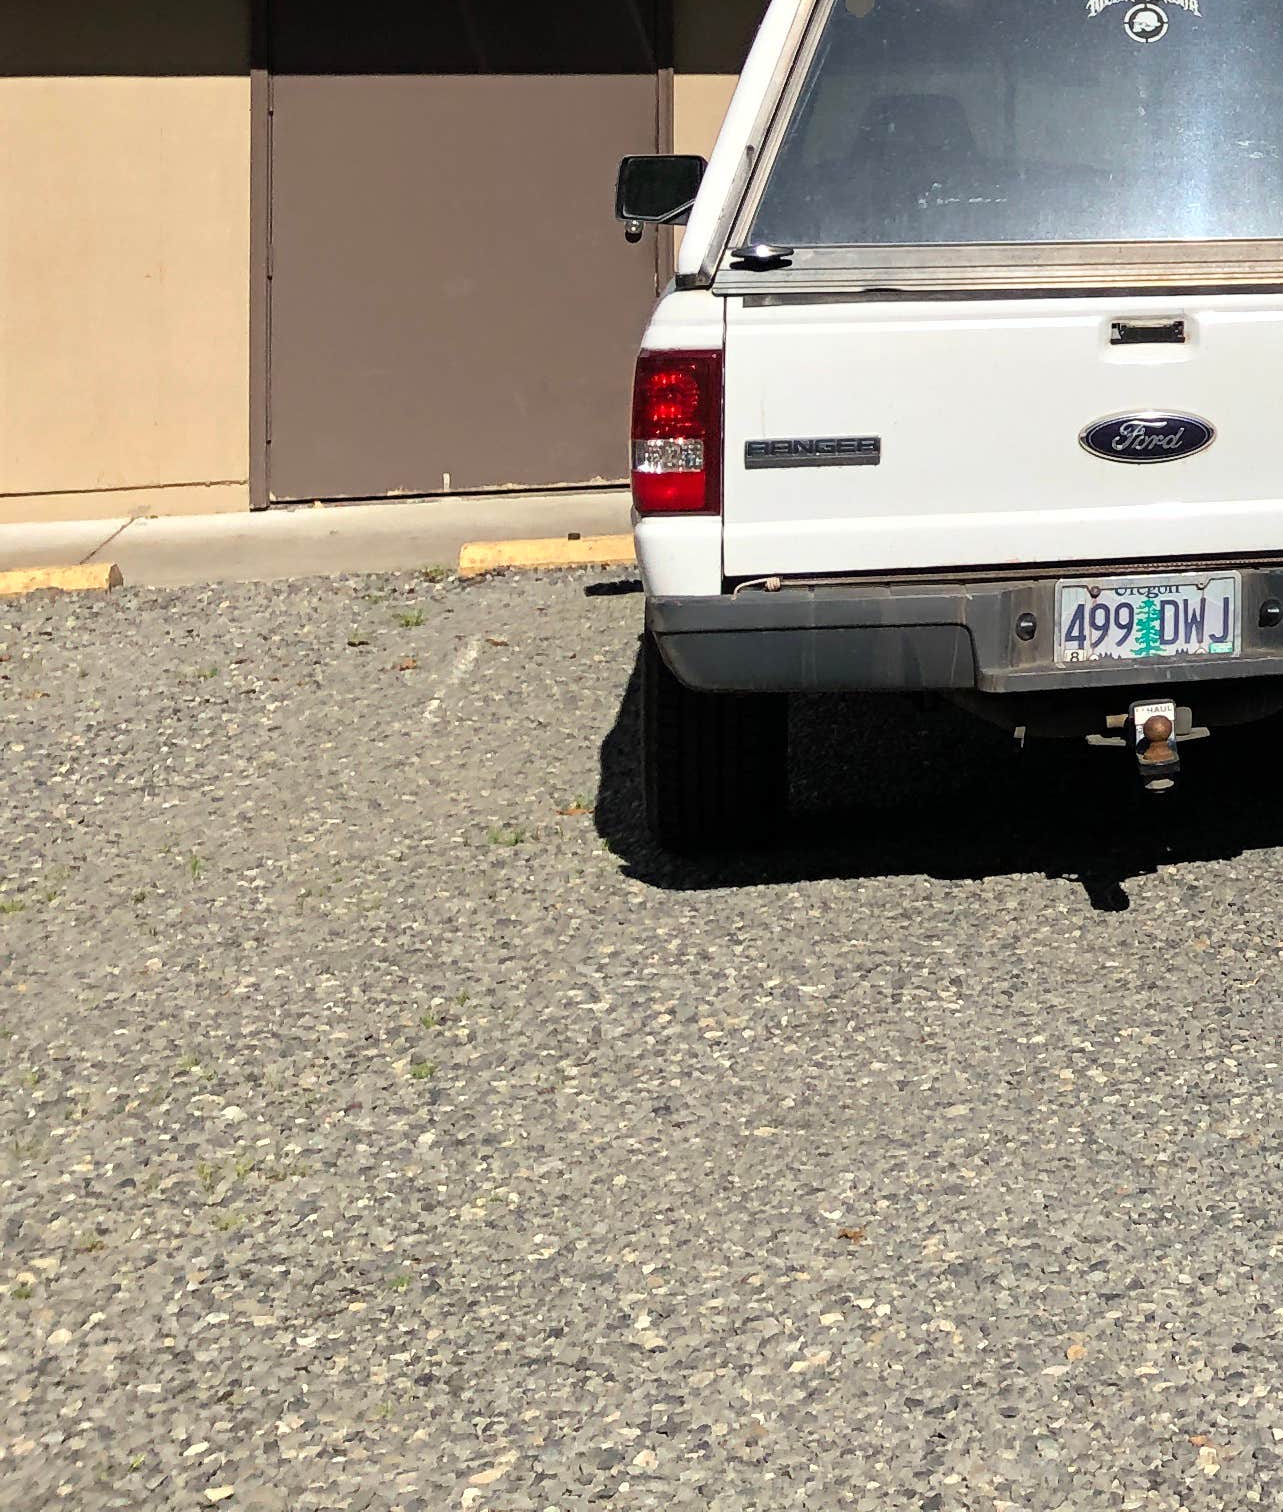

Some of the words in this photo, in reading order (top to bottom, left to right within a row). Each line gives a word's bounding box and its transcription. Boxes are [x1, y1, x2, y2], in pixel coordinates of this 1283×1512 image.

[1111, 419, 1185, 451] Ford
[1064, 602, 1135, 650] 499
[1159, 596, 1230, 646] DWJ
